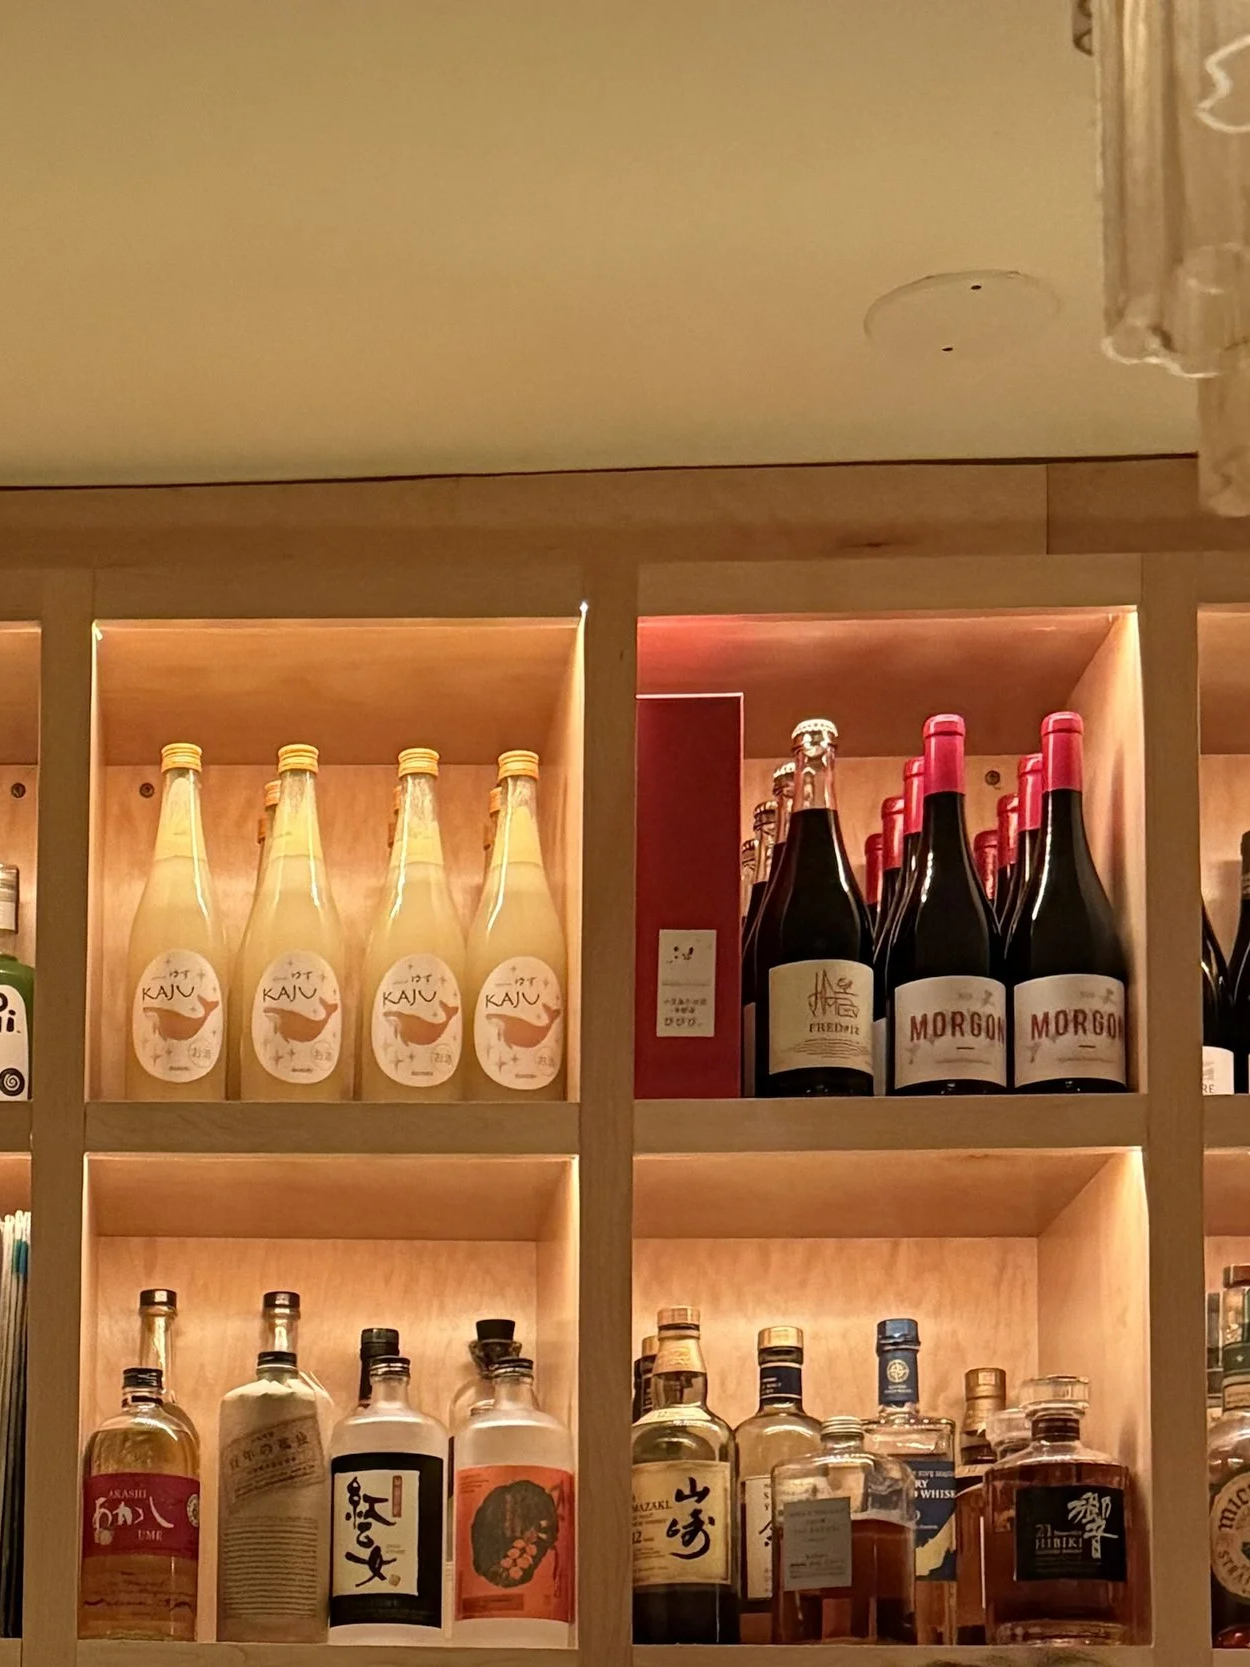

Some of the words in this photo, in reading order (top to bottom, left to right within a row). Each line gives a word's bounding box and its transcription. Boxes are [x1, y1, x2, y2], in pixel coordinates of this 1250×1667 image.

[142, 984, 195, 1001] KAJU
[263, 985, 317, 1002] KAJU
[382, 989, 437, 1006] KAJU
[485, 990, 540, 1008] KAJU
[1035, 1536, 1083, 1549] HIBIKI
